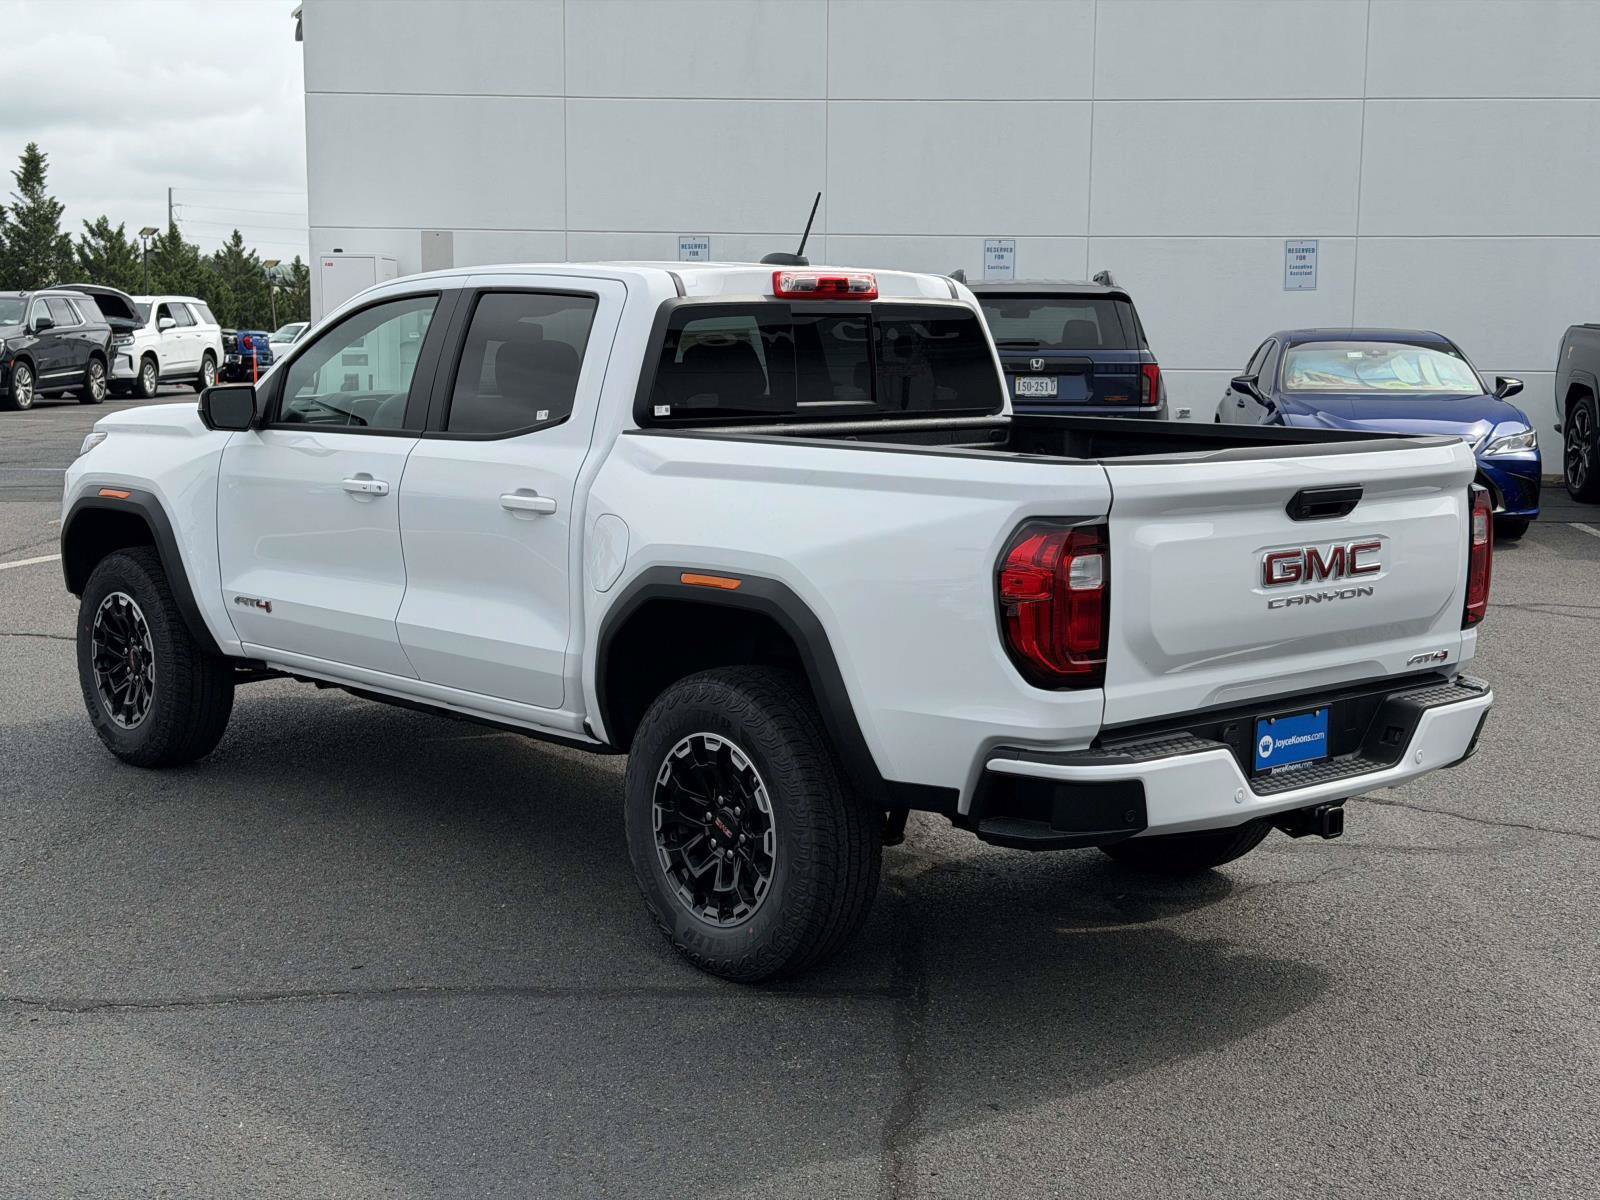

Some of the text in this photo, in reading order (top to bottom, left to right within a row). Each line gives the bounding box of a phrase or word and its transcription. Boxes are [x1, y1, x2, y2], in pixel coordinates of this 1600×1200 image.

[1261, 539, 1382, 588] GMC
[233, 595, 273, 613] AT4
[1267, 586, 1374, 610] CANYON
[1406, 649, 1449, 666] AT4
[1274, 732, 1325, 749] JoyceKoons.com
